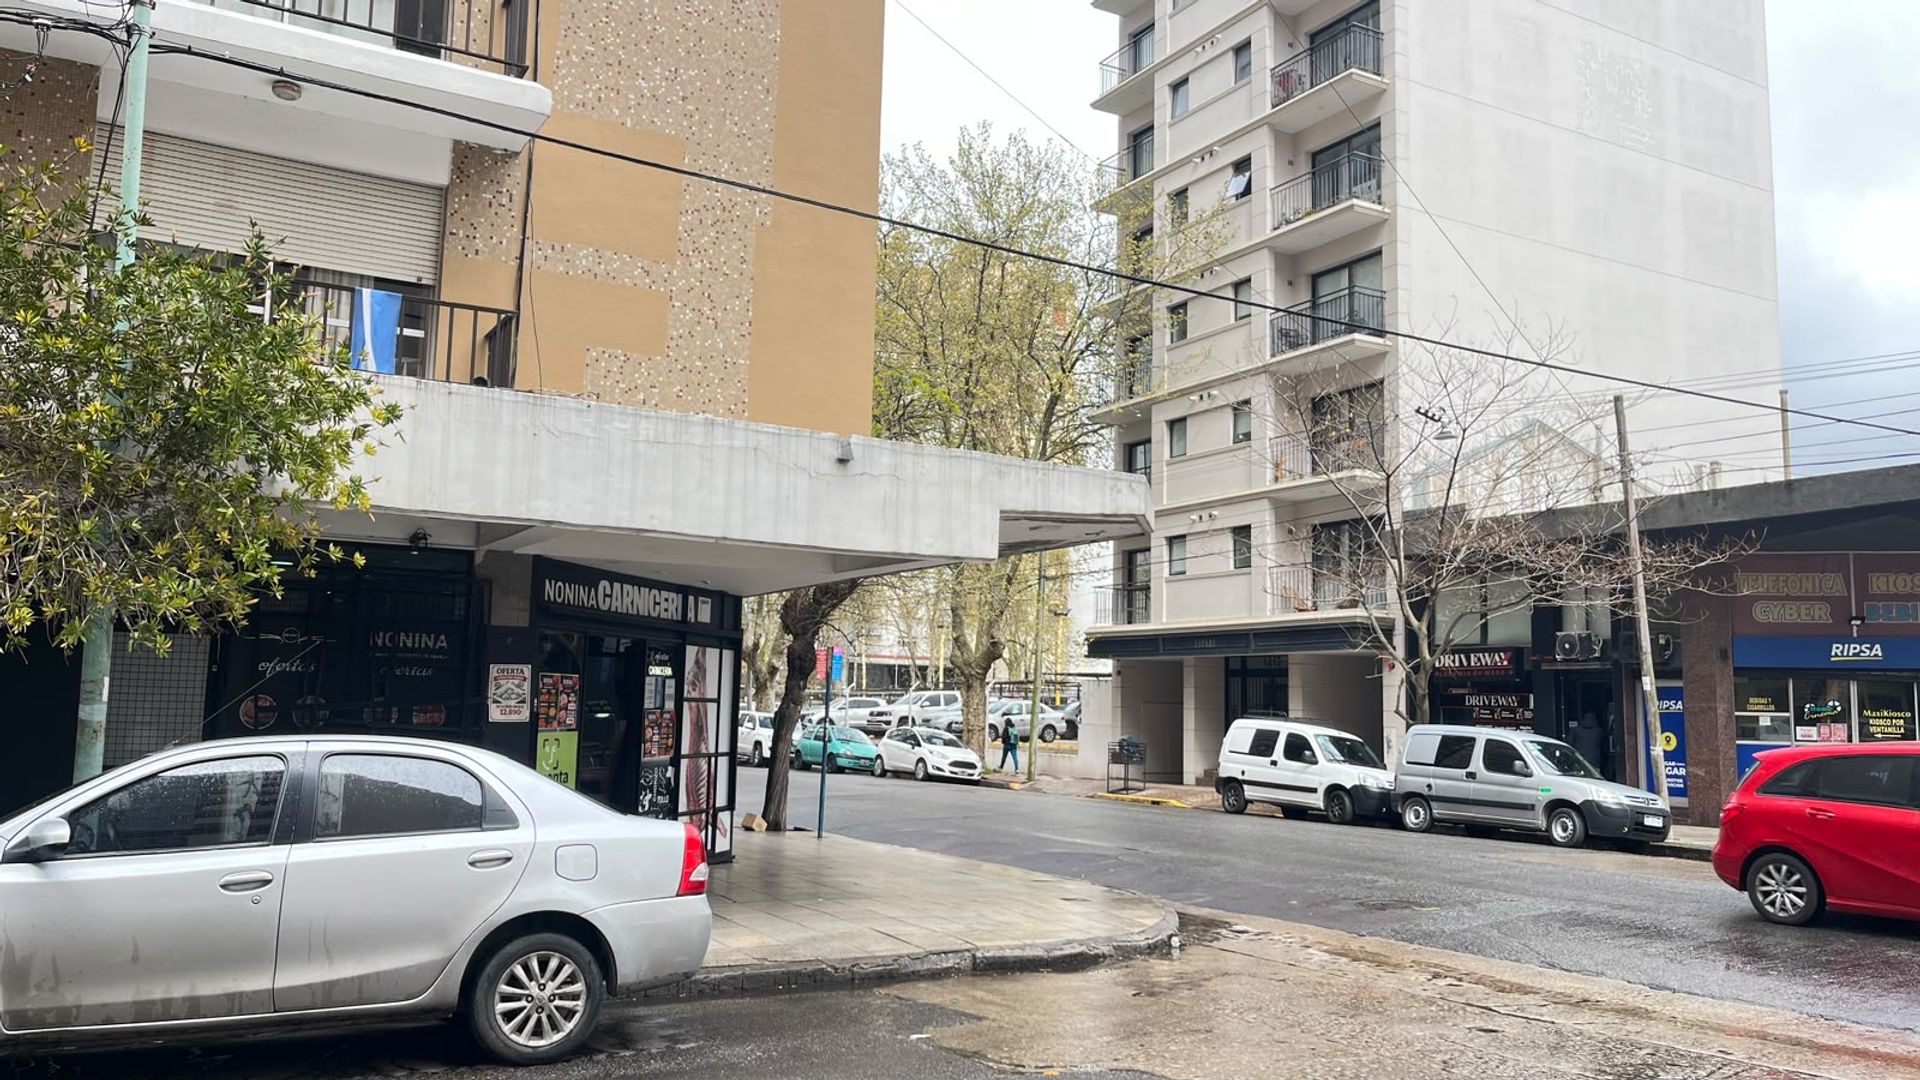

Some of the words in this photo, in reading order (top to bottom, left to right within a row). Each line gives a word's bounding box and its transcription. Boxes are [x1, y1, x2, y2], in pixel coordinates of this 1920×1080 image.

[1736, 573, 1847, 596] TELEFONICA
[545, 579, 597, 609] NONINA
[1752, 601, 1832, 622] CYBER
[1831, 644, 1882, 656] RIPSA
[1435, 652, 1511, 667] DRIVEWAY
[1465, 695, 1519, 706] DRIVEWAY
[1863, 709, 1911, 717] MaxiKiosco
